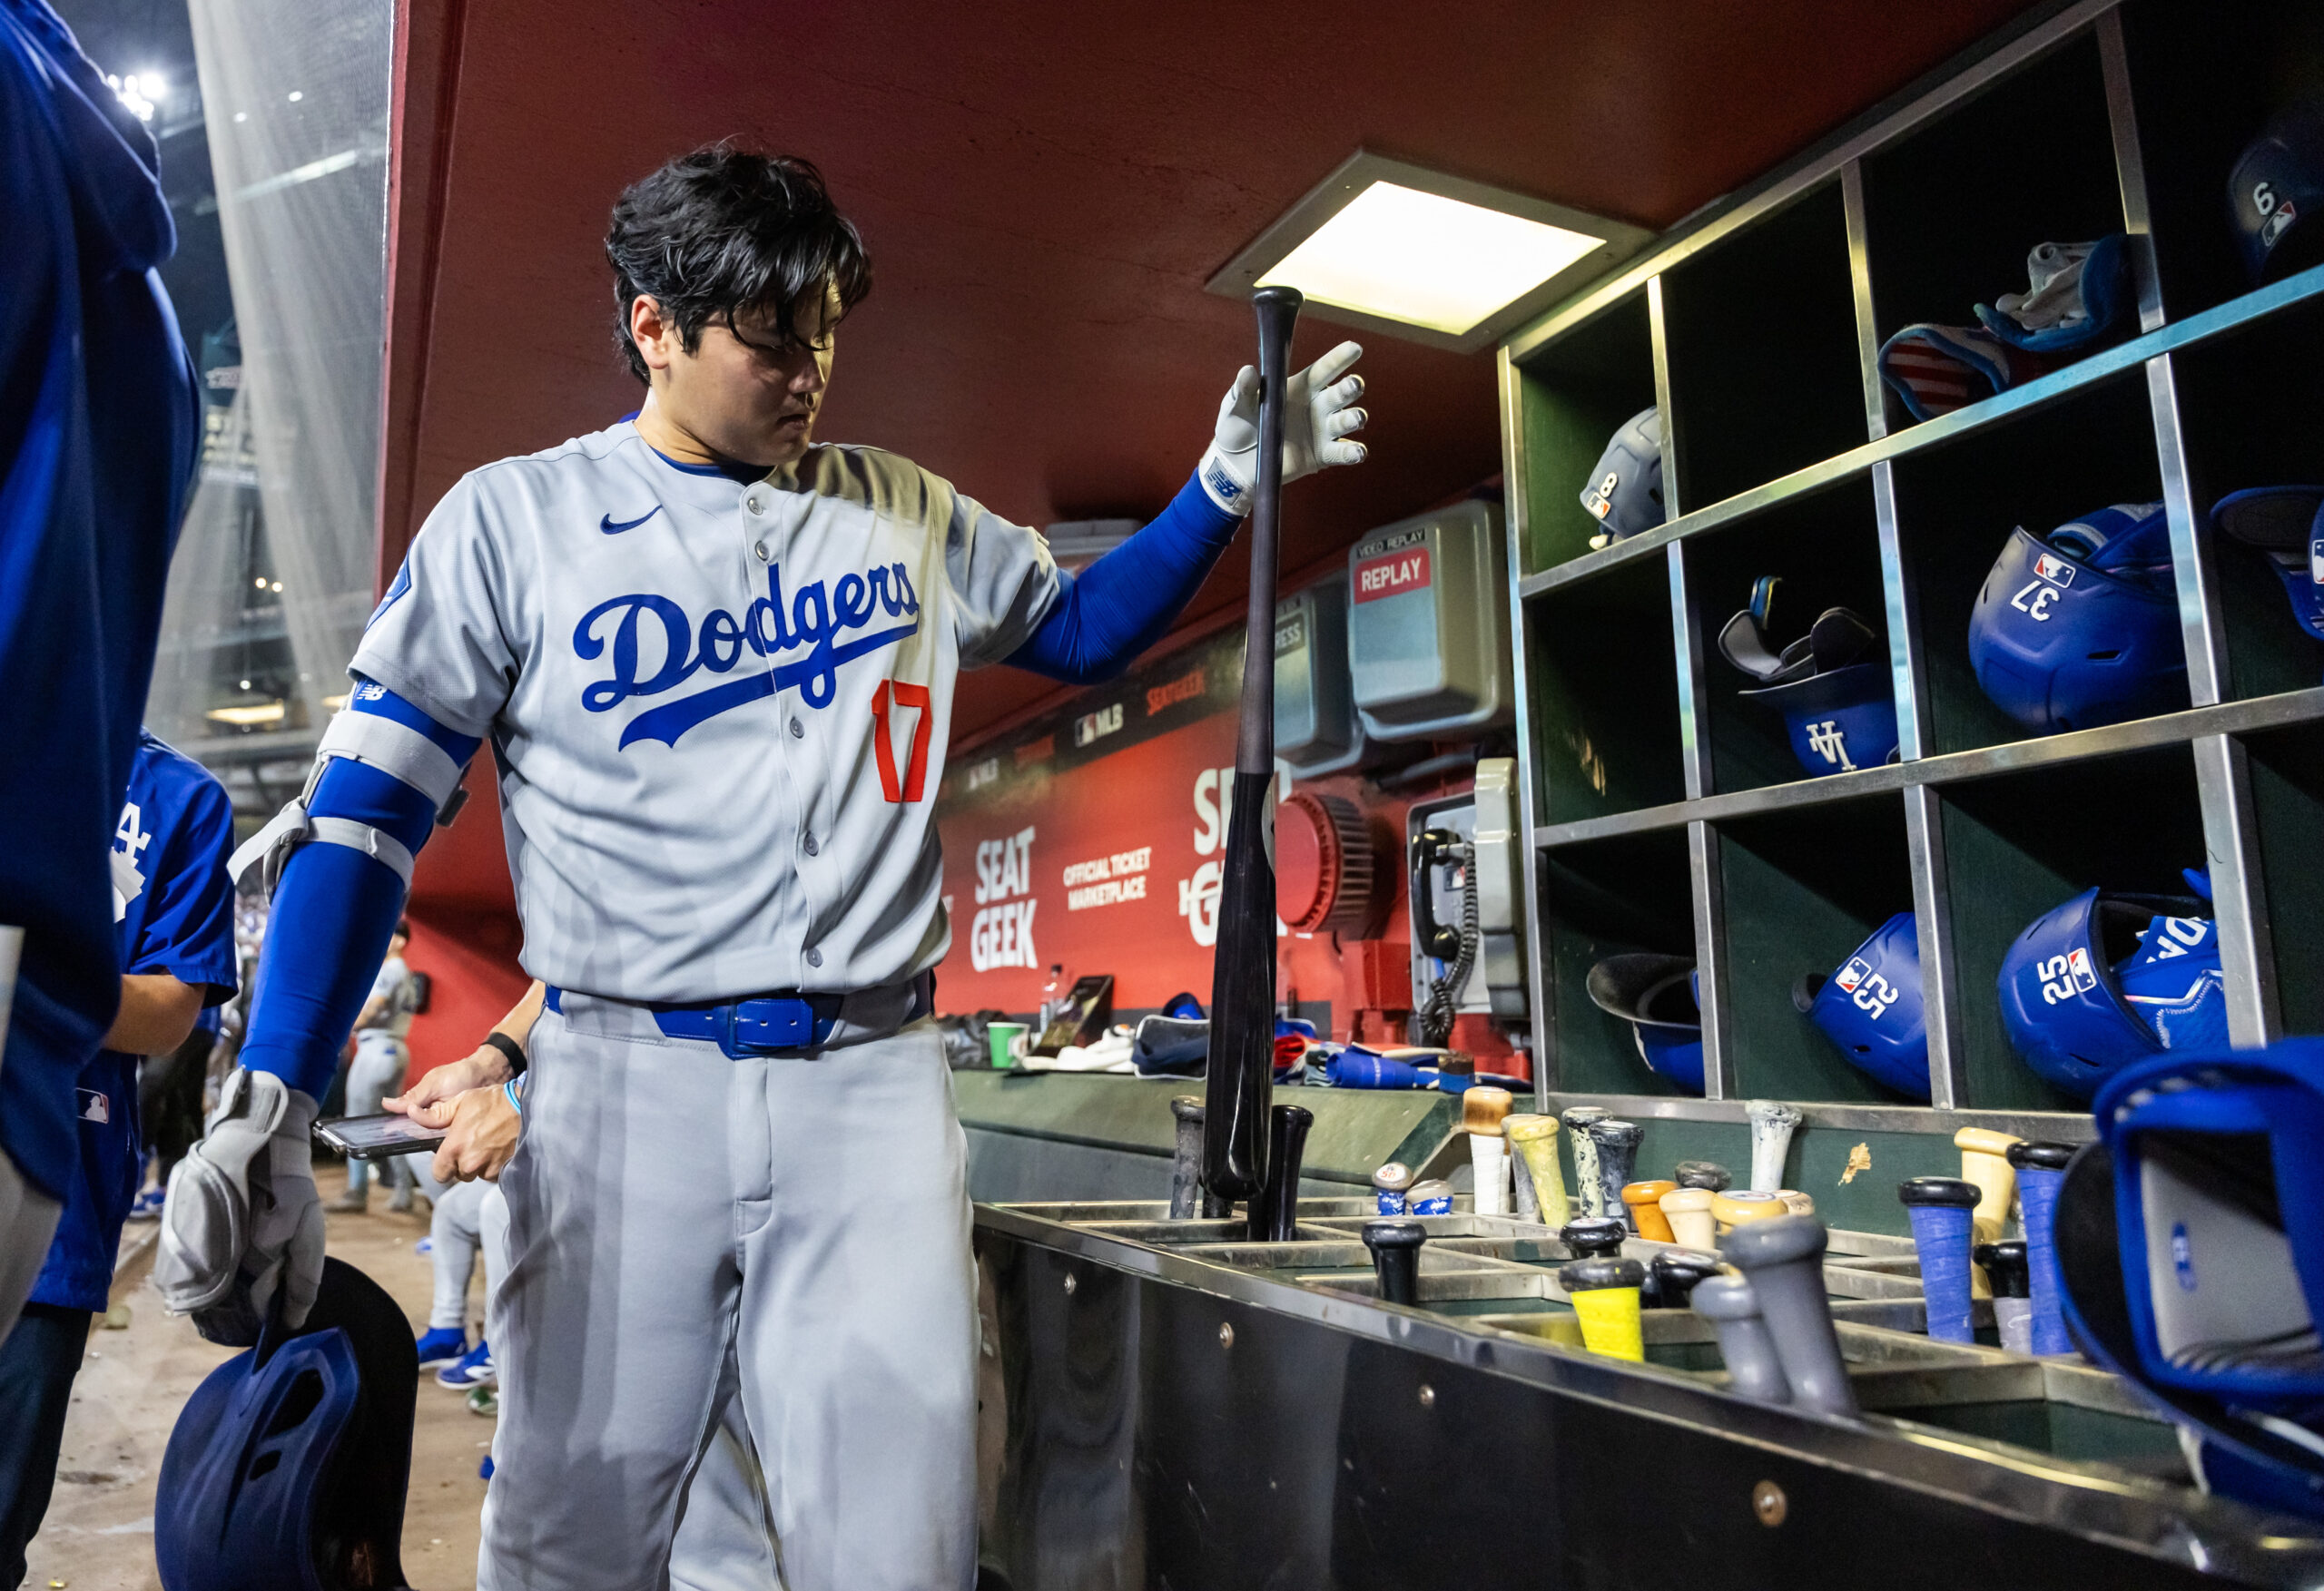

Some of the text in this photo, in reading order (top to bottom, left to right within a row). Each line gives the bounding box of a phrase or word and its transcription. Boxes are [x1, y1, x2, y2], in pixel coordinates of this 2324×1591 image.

[2253, 182, 2275, 215] 6
[1600, 472, 1618, 498] 8
[1358, 529, 1423, 557] VIDEO REPLAY
[1362, 557, 1422, 592] REPLAY
[2011, 580, 2060, 622] 37
[573, 562, 920, 712] Dodgers
[1275, 623, 1302, 648] RESS
[872, 679, 932, 802] 17
[1095, 703, 1124, 737] MLB
[975, 825, 1035, 905] SEAT
[1063, 846, 1152, 887] OFFICIAL TICKET
[1068, 875, 1147, 911] MARKETPLACE
[970, 899, 1039, 972] GEEK
[1854, 973, 1899, 1020] 25
[2037, 955, 2076, 1005] 25
